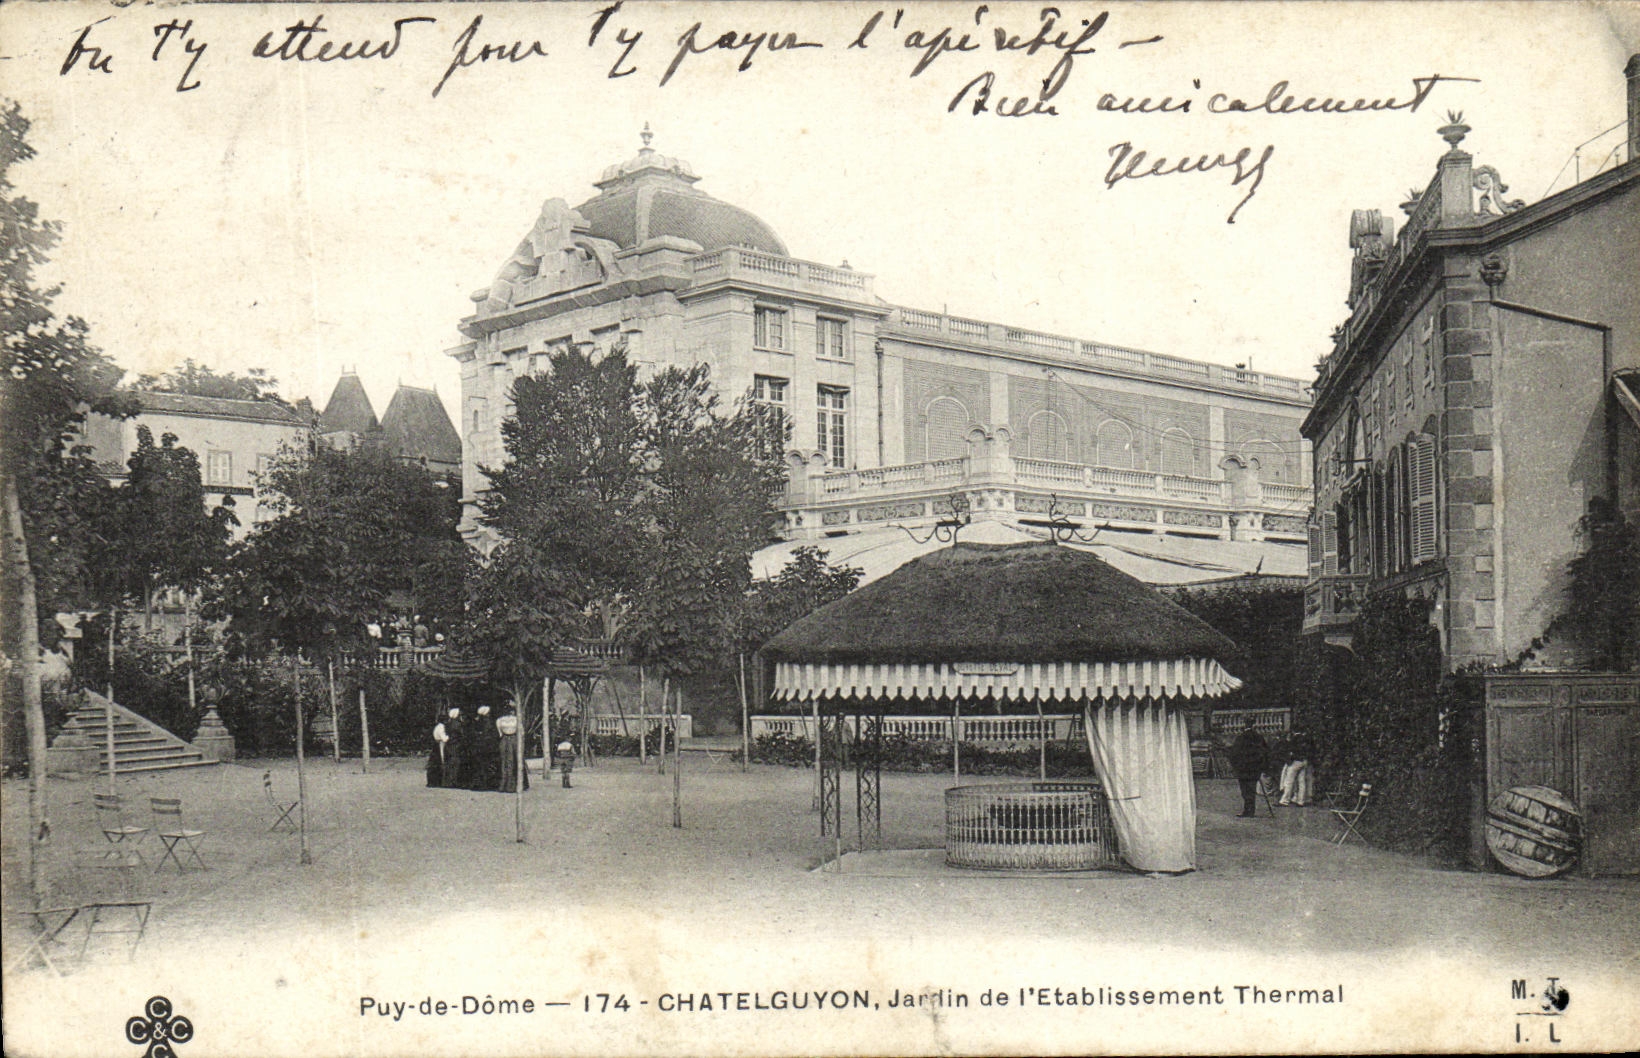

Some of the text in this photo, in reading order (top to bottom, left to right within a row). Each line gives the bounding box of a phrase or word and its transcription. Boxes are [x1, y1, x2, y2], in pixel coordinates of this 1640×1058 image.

[431, 14, 548, 98] pour
[659, 22, 824, 87] payer
[948, 71, 1482, 119] Bien amicalement
